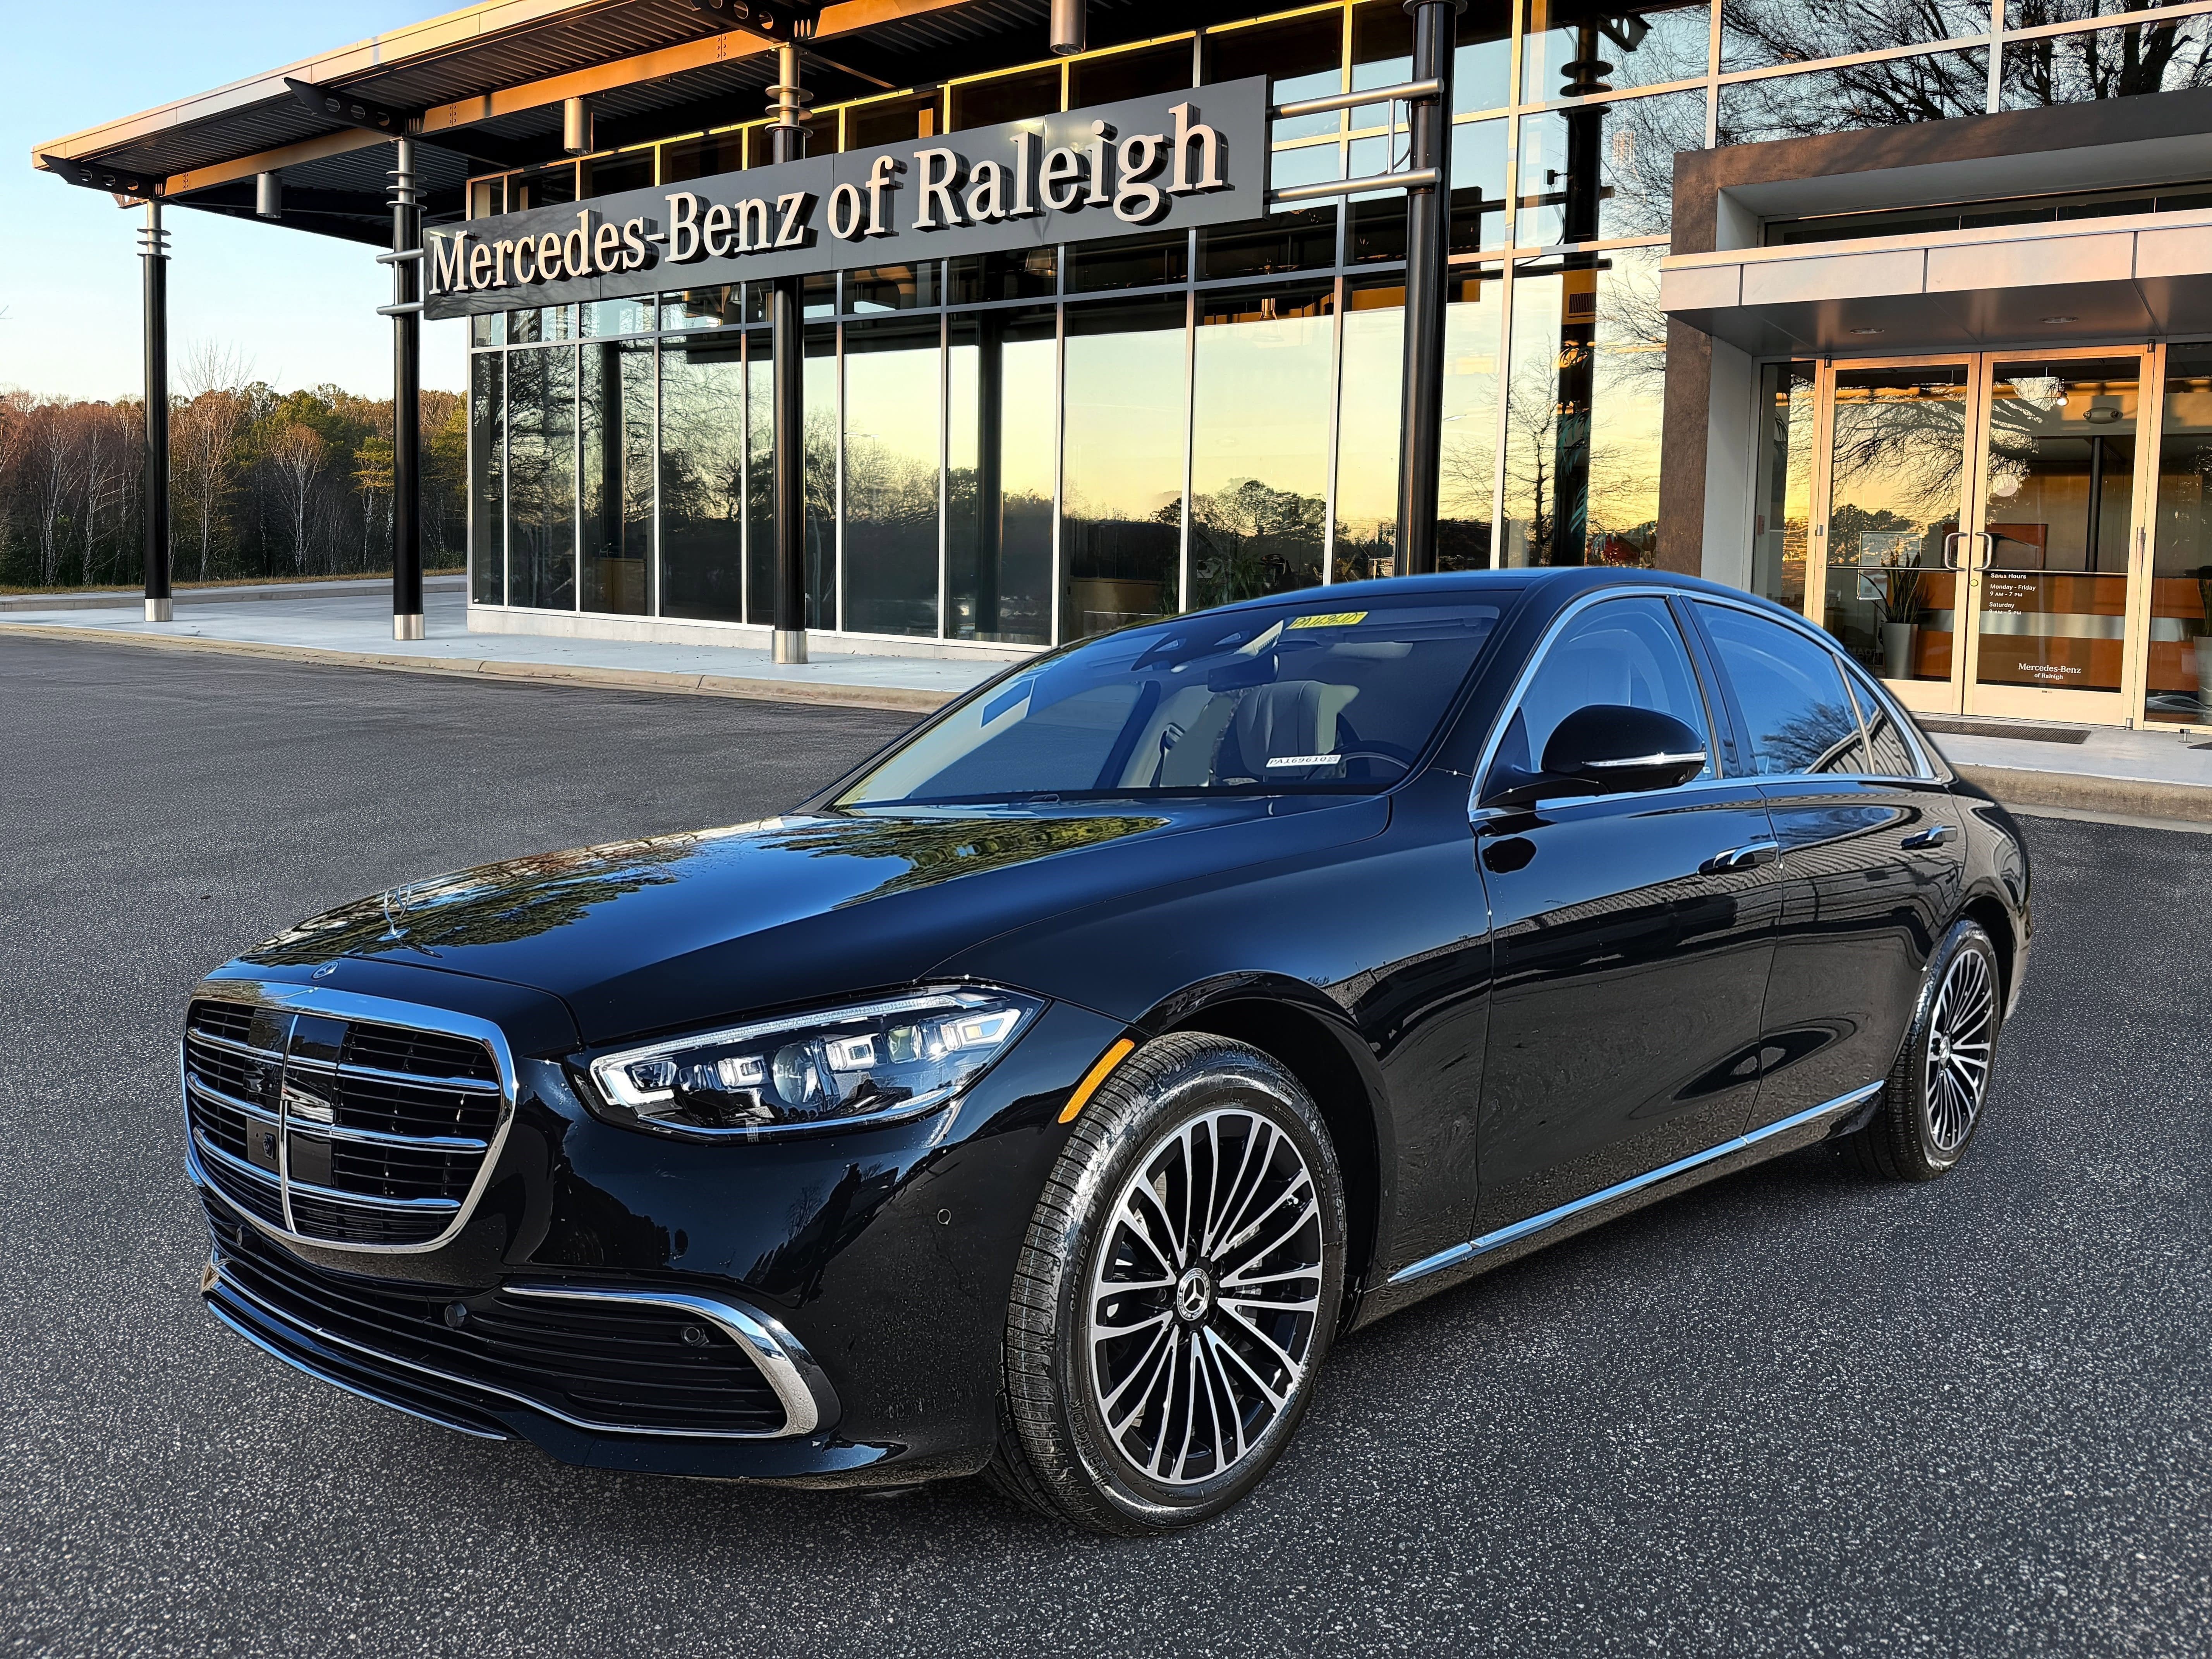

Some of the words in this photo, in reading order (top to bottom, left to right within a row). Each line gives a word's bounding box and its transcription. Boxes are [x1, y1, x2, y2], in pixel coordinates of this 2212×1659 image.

[428, 191, 806, 295] Mercedes-Benz
[826, 155, 894, 239] of
[912, 101, 1224, 223] Raleigh
[2018, 663, 2081, 674] Mercedes-Benz
